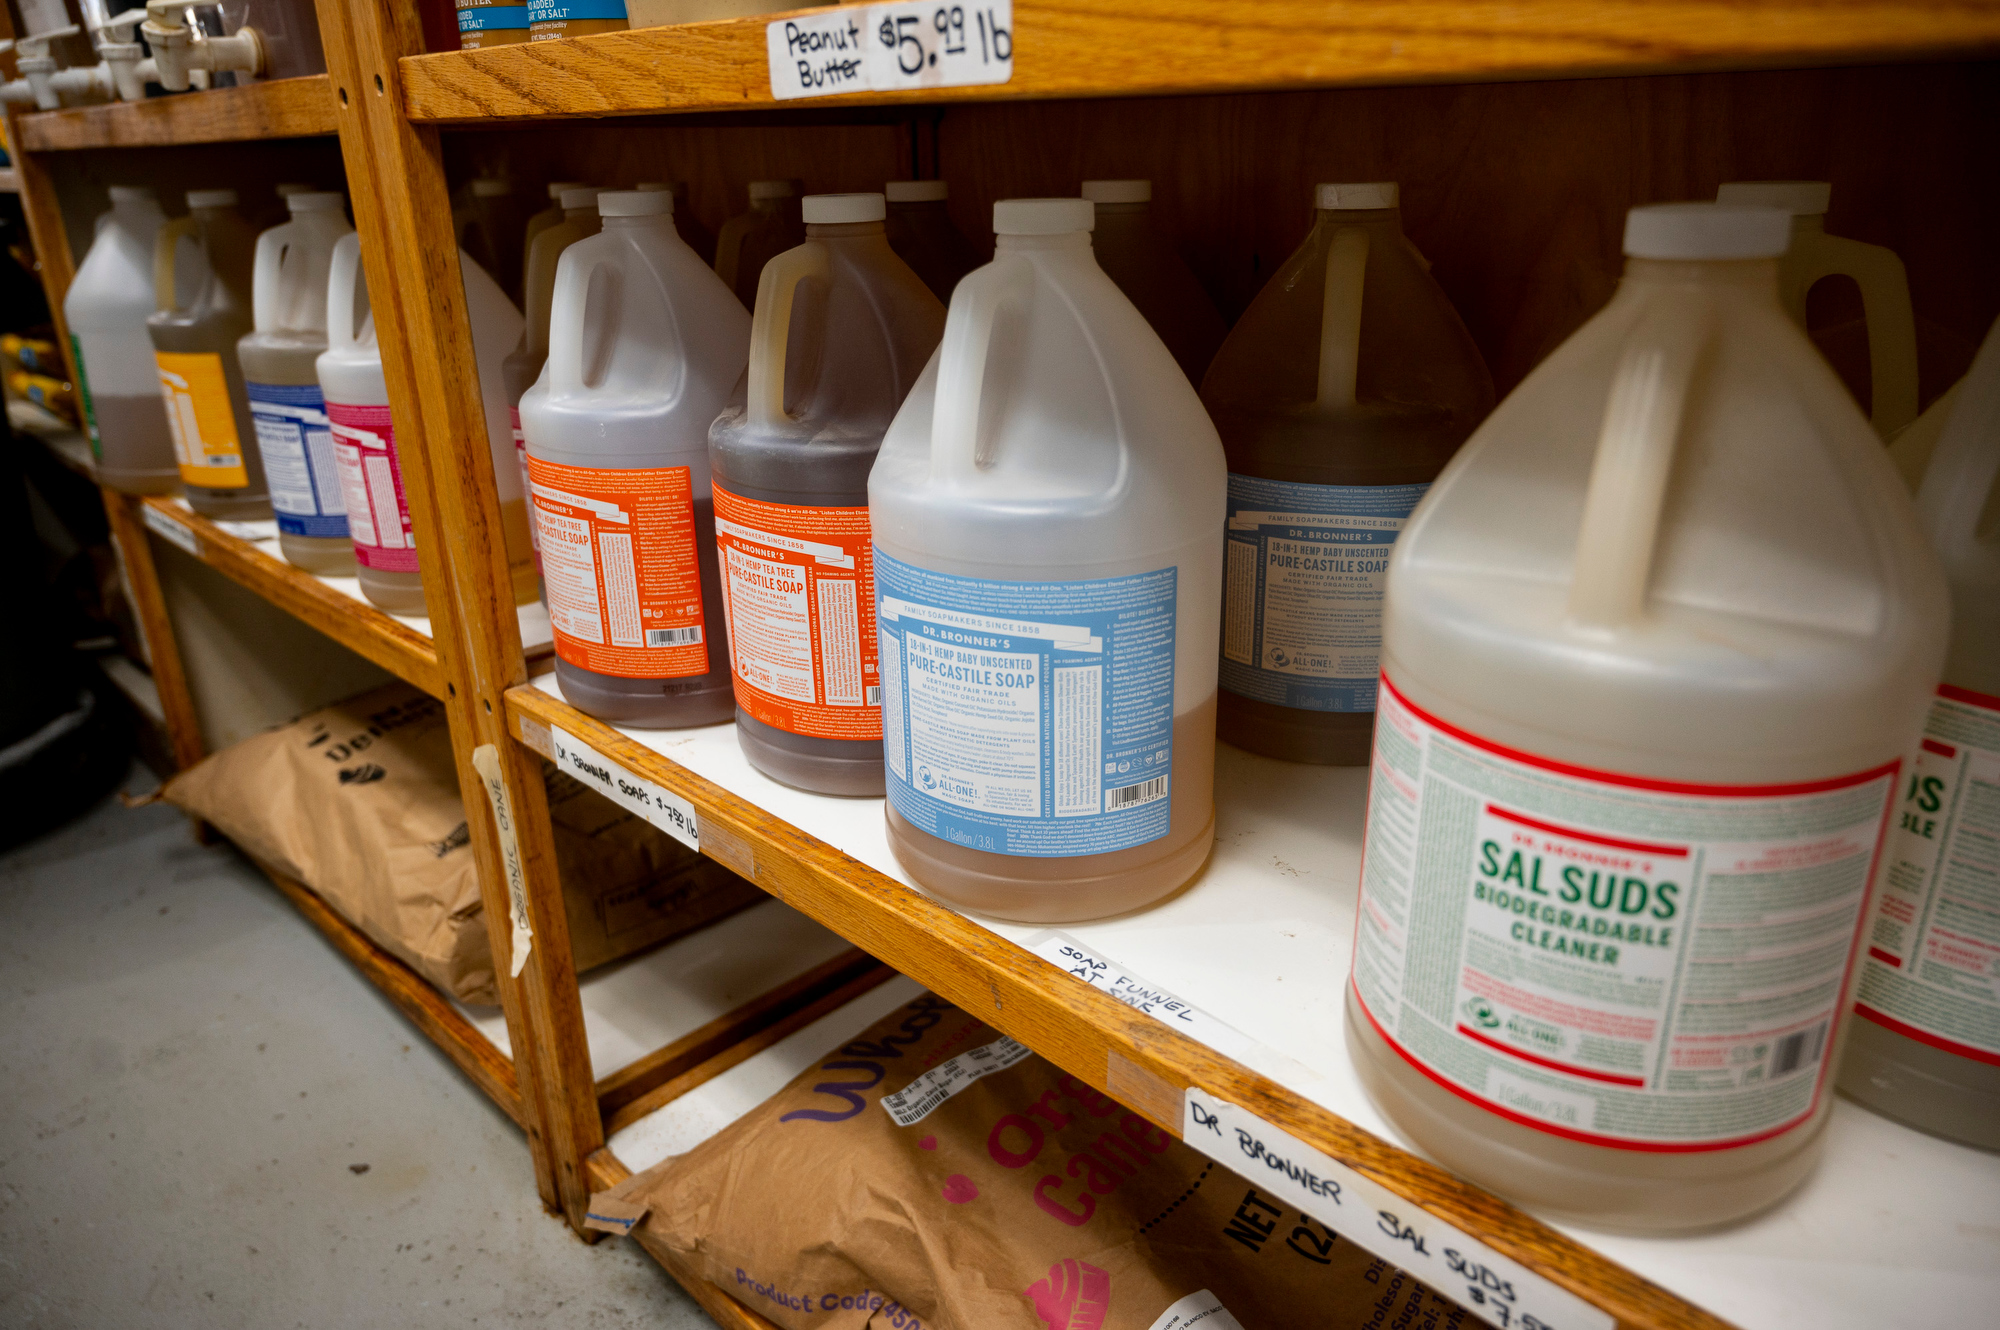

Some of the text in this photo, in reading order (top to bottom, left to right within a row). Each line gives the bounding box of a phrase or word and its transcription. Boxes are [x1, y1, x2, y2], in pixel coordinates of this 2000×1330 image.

[534, 0, 554, 9] ADDED
[538, 10, 546, 19] OR
[785, 6, 1012, 74] Peanut $5.99 lb
[798, 59, 861, 87] Butter
[541, 500, 573, 515] BRONNER'S
[557, 519, 567, 528] TEA
[568, 521, 582, 531] TREE
[1296, 516, 1350, 525] SOAPMAKERS
[1379, 520, 1397, 528] 1858
[569, 533, 588, 545] SOAP
[735, 526, 804, 549] SOAPMAKERS SINCE 1858
[1289, 529, 1373, 541] DR. BRONNER'S
[742, 542, 785, 560] BRONNER'S
[1272, 542, 1389, 558] 18-IN-1 HEMP BABY UNSCENTED
[746, 557, 762, 570] HEMP
[763, 564, 776, 575] TEA
[777, 567, 795, 578] TREE
[1270, 554, 1389, 573] PURE-CASTILE SOAP
[729, 562, 804, 595] PURE-CASTILE SOAP
[1084, 582, 1106, 590] Children
[1126, 578, 1142, 586] Father
[1143, 573, 1162, 583] Eternally
[1288, 572, 1323, 580] CERTIFIED
[758, 590, 768, 598] FAIR
[770, 593, 787, 601] TRADE
[904, 606, 1040, 634] FAMILY SOAPMAKERS SINCE 1858
[923, 625, 1010, 648] DR. BRONNER'S
[910, 638, 1032, 670] 18-IN-1 HEMP BABY UNSCENTED
[1293, 656, 1332, 668] ALL-ONE!
[910, 653, 1035, 689] PURE-CASTILE SOAP
[922, 683, 939, 693] MADE
[941, 688, 958, 698] WITH
[960, 692, 994, 704] ORGANIC
[926, 677, 1010, 698] CERTIFIED FAIR TRADE
[940, 724, 956, 733] MEANS
[957, 728, 969, 736] SOAP
[949, 732, 974, 743] SYNTHETIC
[976, 738, 1010, 748] DETERGENTS
[571, 753, 613, 787] BRONNER
[618, 779, 650, 805] SOAPS
[686, 817, 698, 839] lb
[939, 780, 978, 799] ALL-ONE!
[958, 796, 975, 805] SOAPS
[951, 828, 972, 846] Gallon
[979, 834, 995, 850] 3.8L
[491, 779, 529, 930] ORGANIC CANE
[1479, 838, 1680, 920] SAL SUDS
[1473, 879, 1673, 947] BIODEGRADABLE
[1511, 920, 1620, 966] CLEANER
[1059, 946, 1193, 1022] SOAP FUNNEL
[1070, 965, 1104, 983] AT
[987, 1074, 1121, 1169] Org
[1033, 1113, 1171, 1228] Cane
[1190, 1100, 1516, 1302] DR BRONNER SAL SUDS
[1222, 1189, 1282, 1253] NET
[736, 1267, 814, 1313] Product
[820, 1288, 884, 1312] Code
